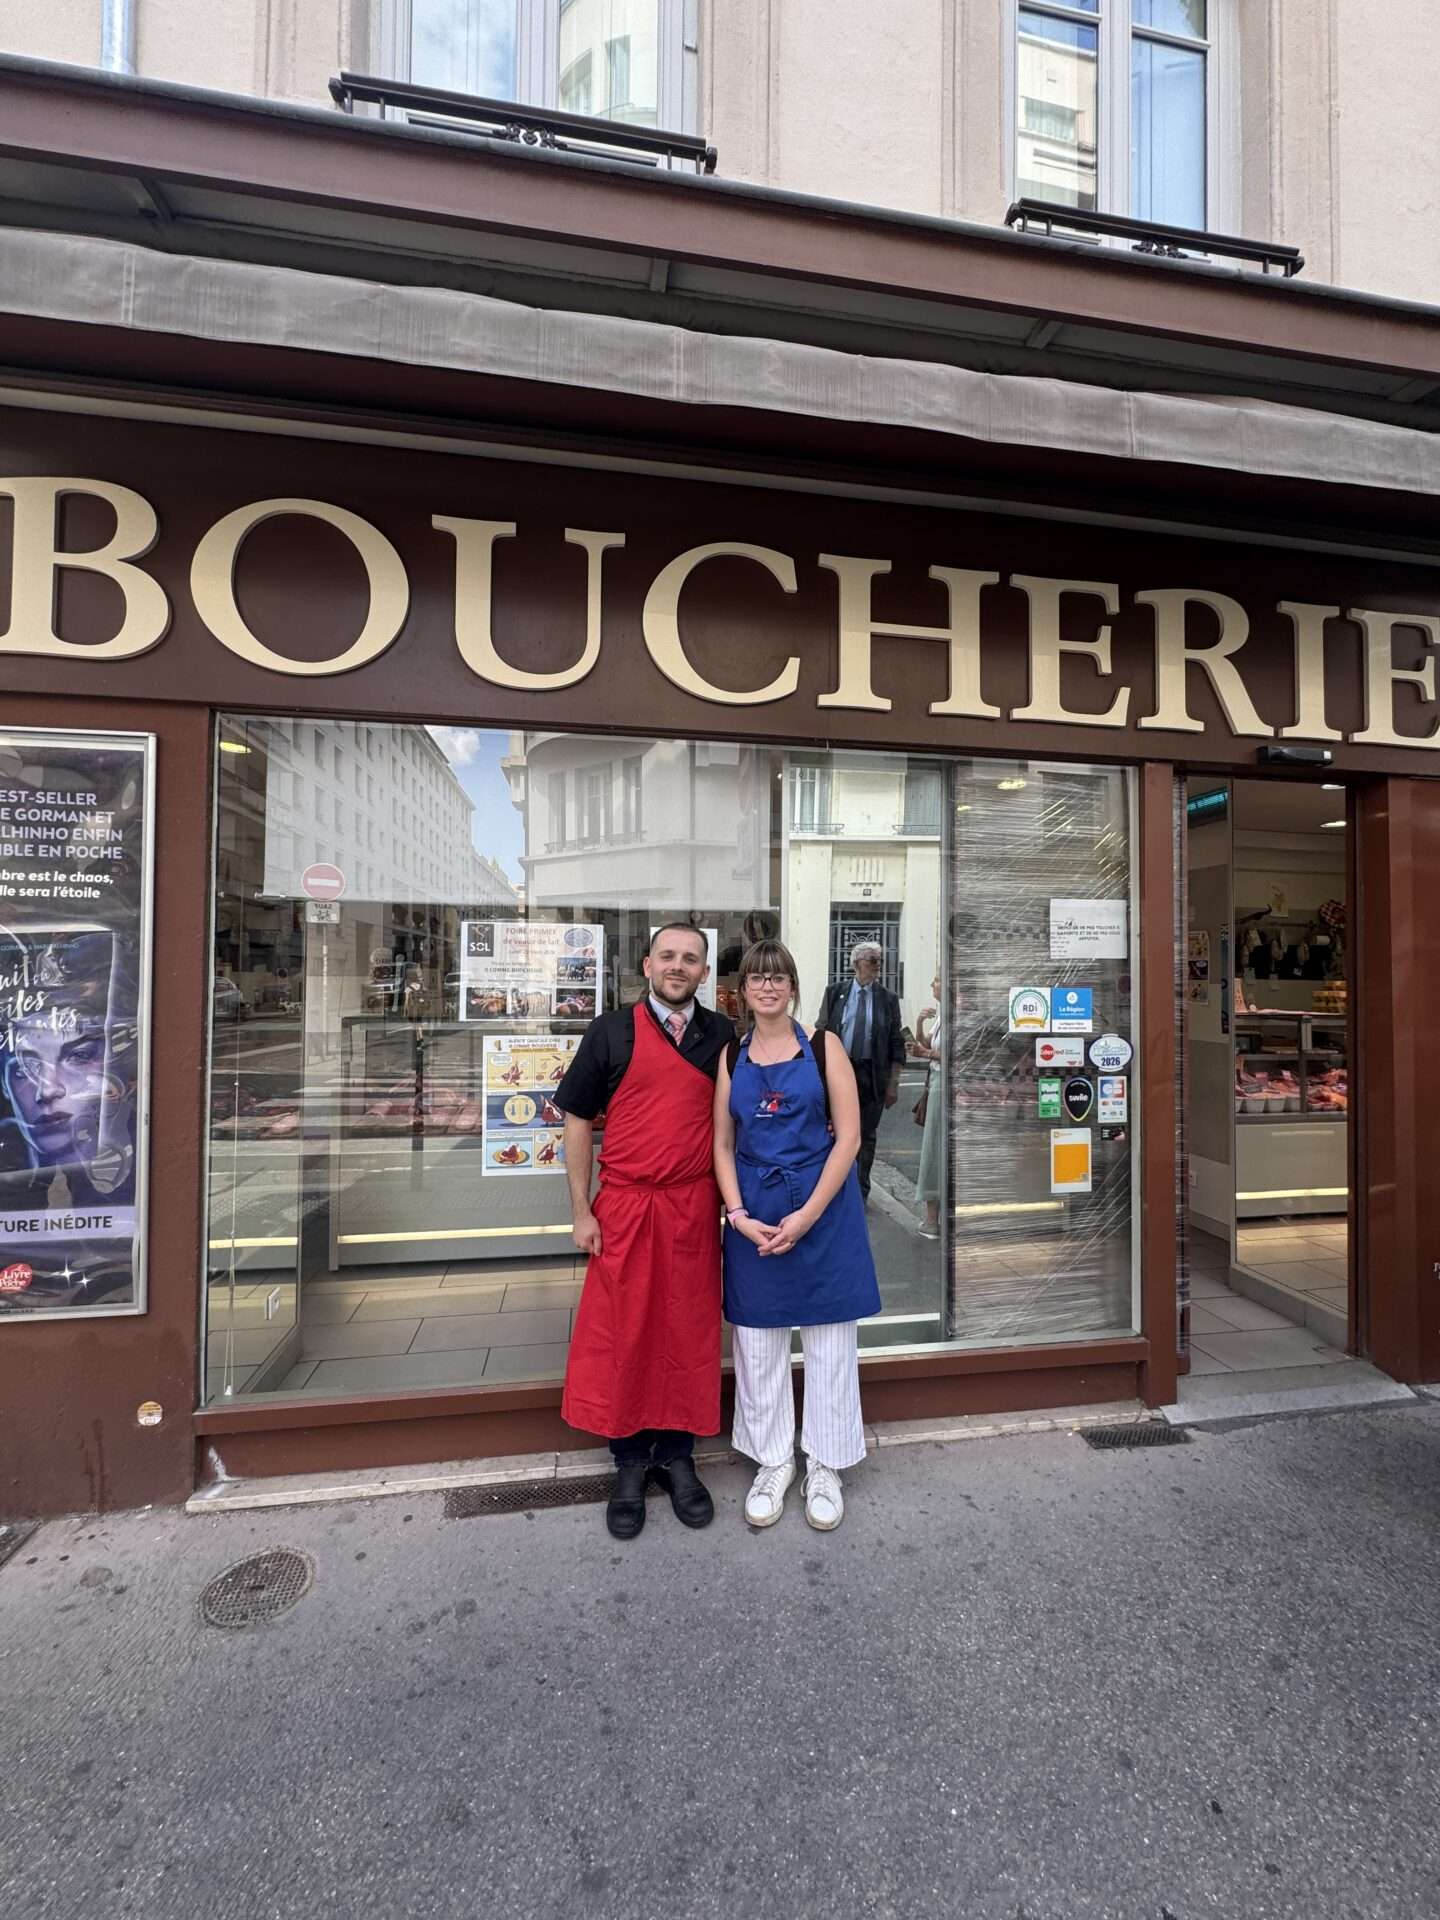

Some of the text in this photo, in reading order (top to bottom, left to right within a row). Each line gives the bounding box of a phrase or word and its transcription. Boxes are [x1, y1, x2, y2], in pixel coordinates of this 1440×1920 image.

[0, 476, 1440, 748] BOUCHERIE
[15, 808, 91, 824] GORMAN
[95, 811, 115, 824] ET
[73, 828, 123, 842] ENFIN
[38, 845, 62, 858] EN
[65, 845, 123, 860] POCHE
[0, 869, 114, 885] bre est le chaos,
[18, 886, 50, 898] sera
[53, 885, 101, 899] l'étoile
[44, 1214, 113, 1232] INÉDITE
[4, 1269, 32, 1281] Livre
